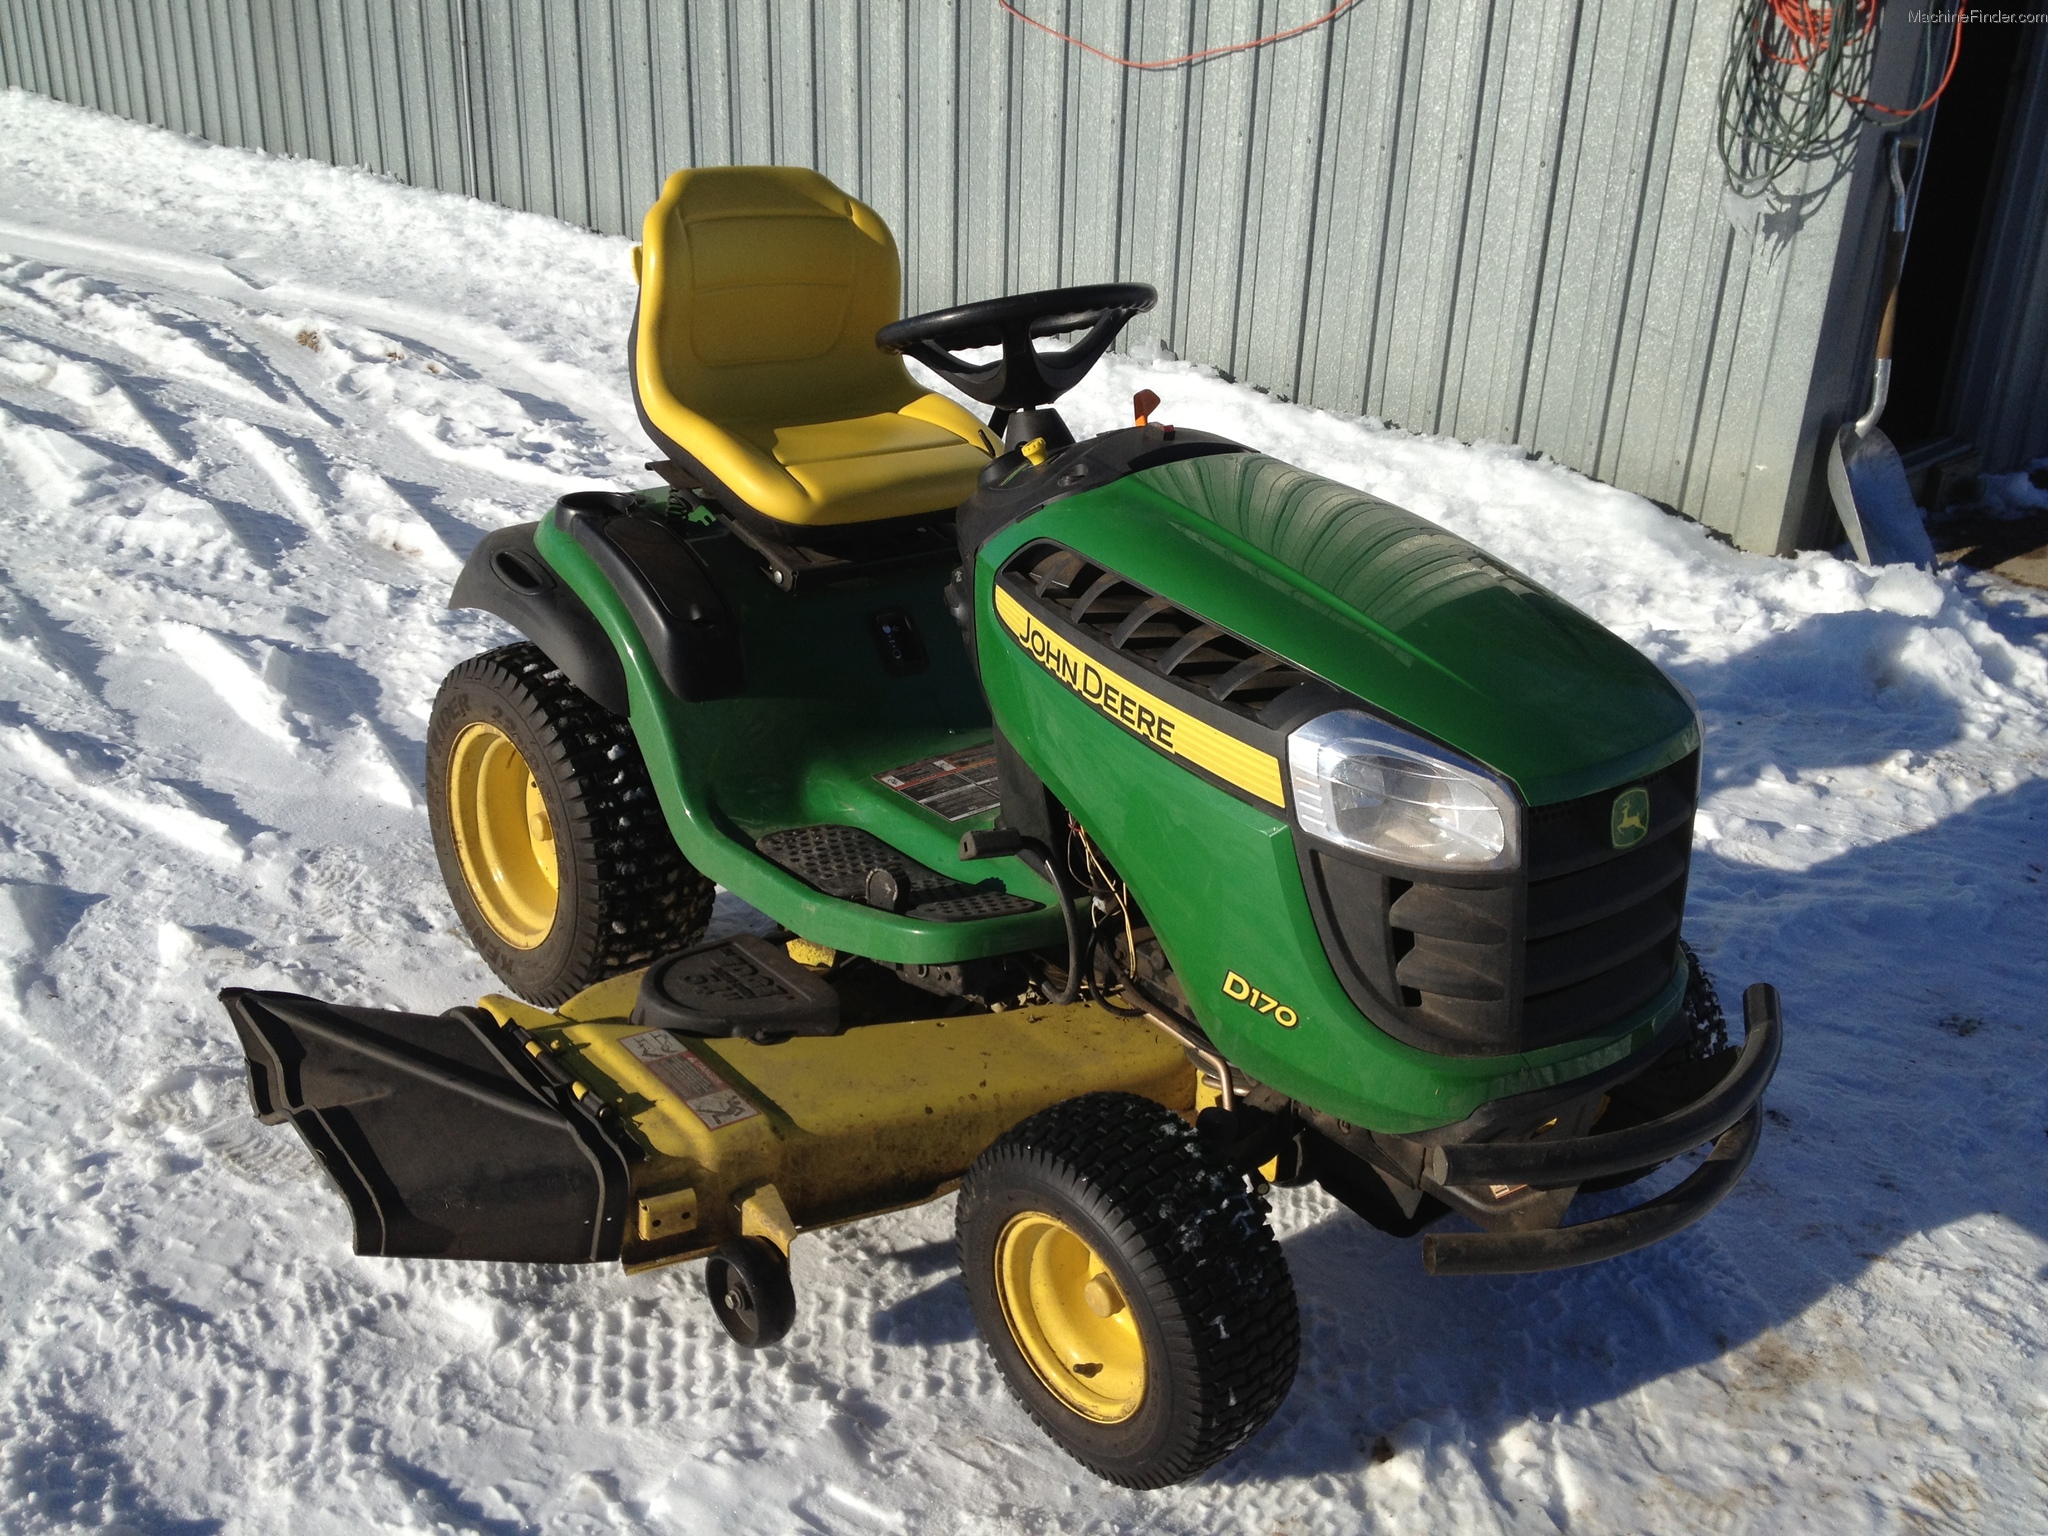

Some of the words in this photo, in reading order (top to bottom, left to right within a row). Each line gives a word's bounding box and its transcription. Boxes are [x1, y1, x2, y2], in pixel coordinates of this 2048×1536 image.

[1019, 616, 1078, 686] JOHN
[1083, 663, 1175, 749] DEERE
[1221, 969, 1299, 1028] D170
